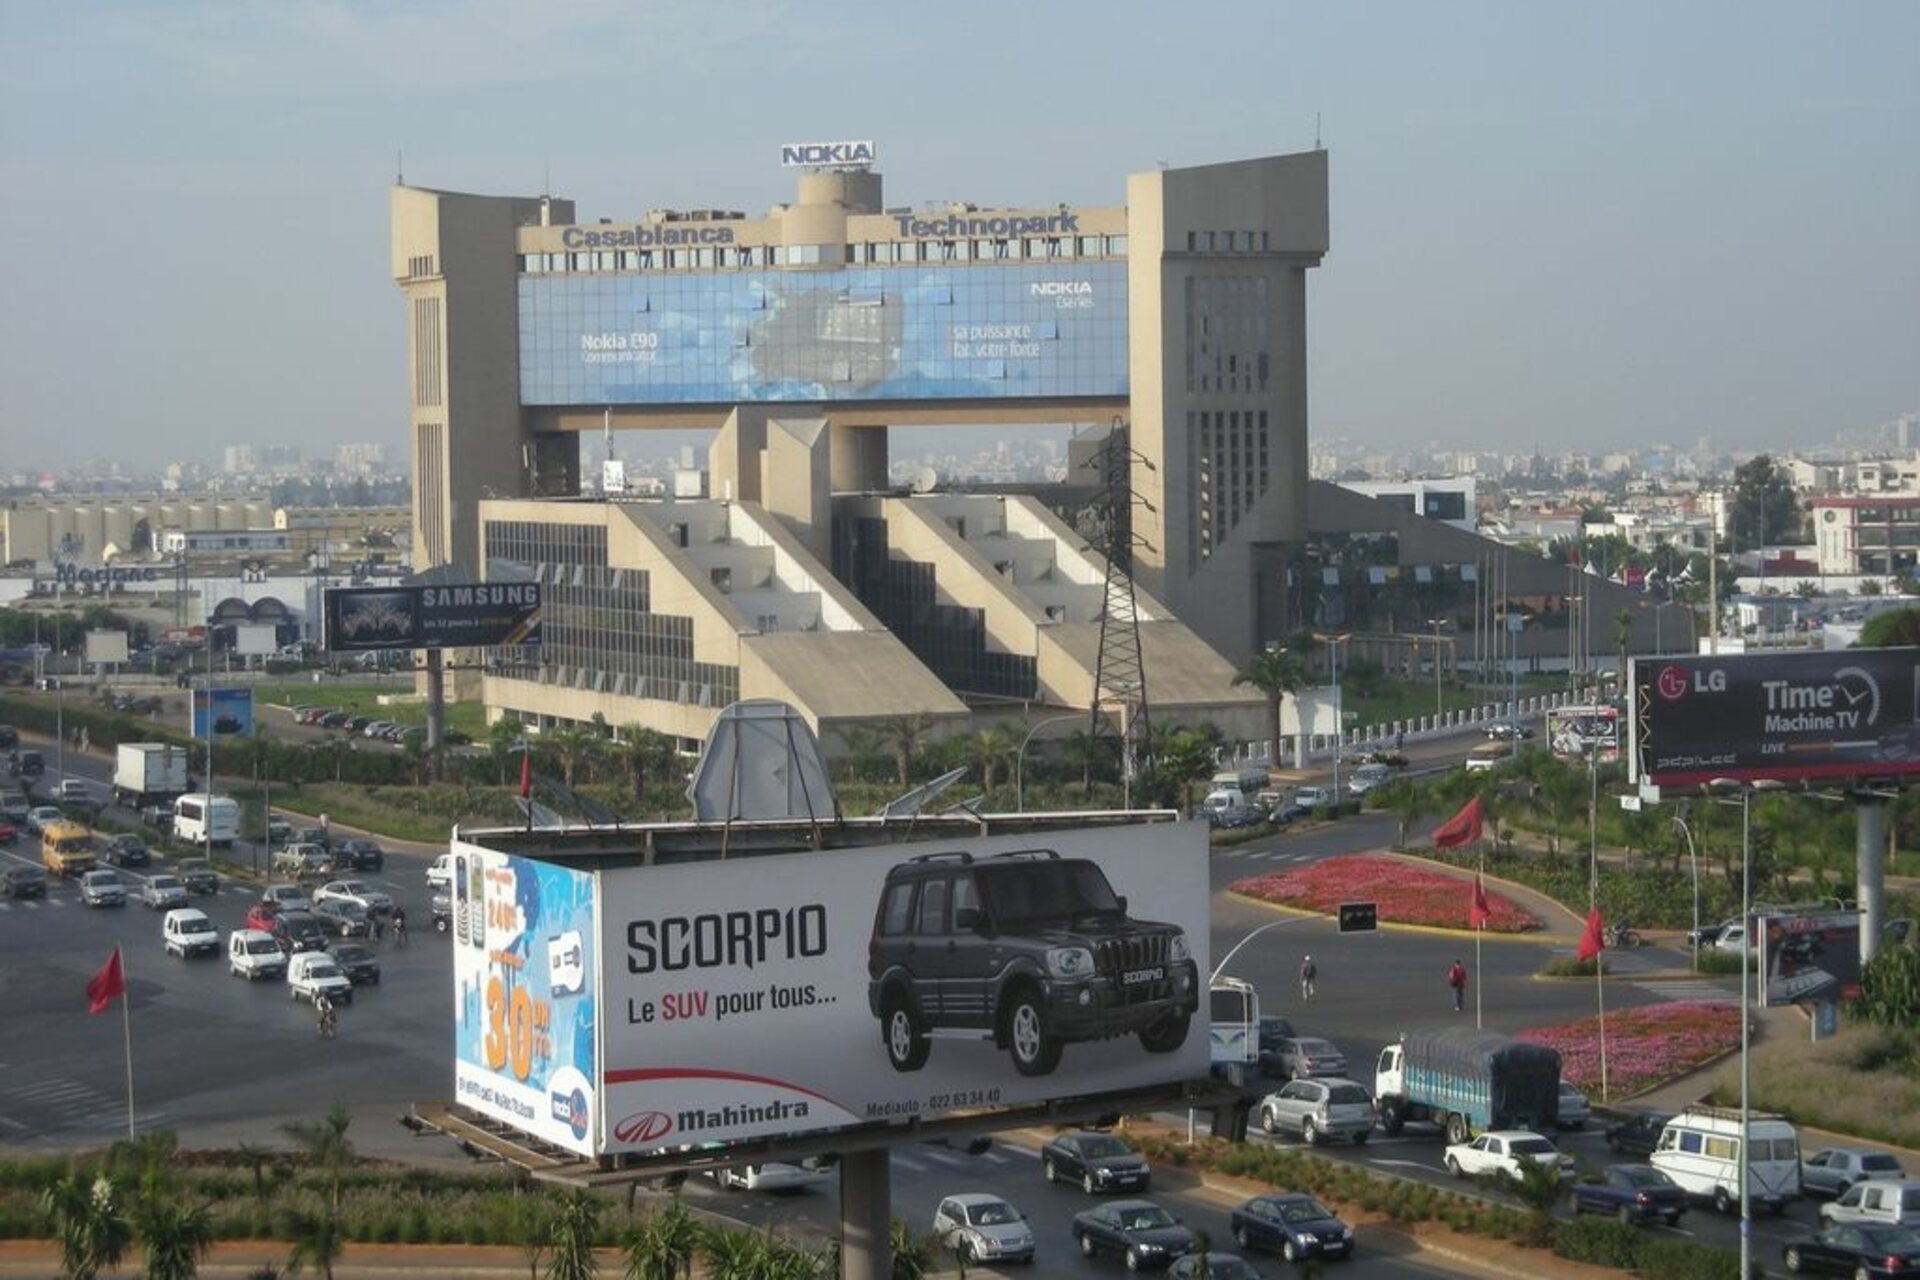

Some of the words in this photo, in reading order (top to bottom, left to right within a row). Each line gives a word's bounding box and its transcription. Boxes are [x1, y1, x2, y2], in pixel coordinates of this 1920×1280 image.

[783, 144, 871, 163] NOKIA
[562, 225, 734, 248] Casablanca
[894, 211, 1079, 239] Technopark
[1031, 282, 1093, 295] NOKIA
[581, 333, 627, 349] Nokia
[422, 586, 537, 607] SAMSUNG
[1694, 670, 1726, 692] LG
[1761, 680, 1834, 710] Time
[1764, 714, 1834, 733] Machine
[1835, 711, 1860, 729] TV
[627, 904, 827, 974] SCORPIO
[628, 998, 655, 1024] Le
[661, 990, 709, 1021] SUV
[716, 990, 765, 1021] pour
[771, 984, 836, 1009] tous...
[484, 976, 533, 1082] 30
[677, 1100, 810, 1132] Mahindra
[866, 1099, 920, 1117] Mediauto
[929, 1093, 950, 1109] 022
